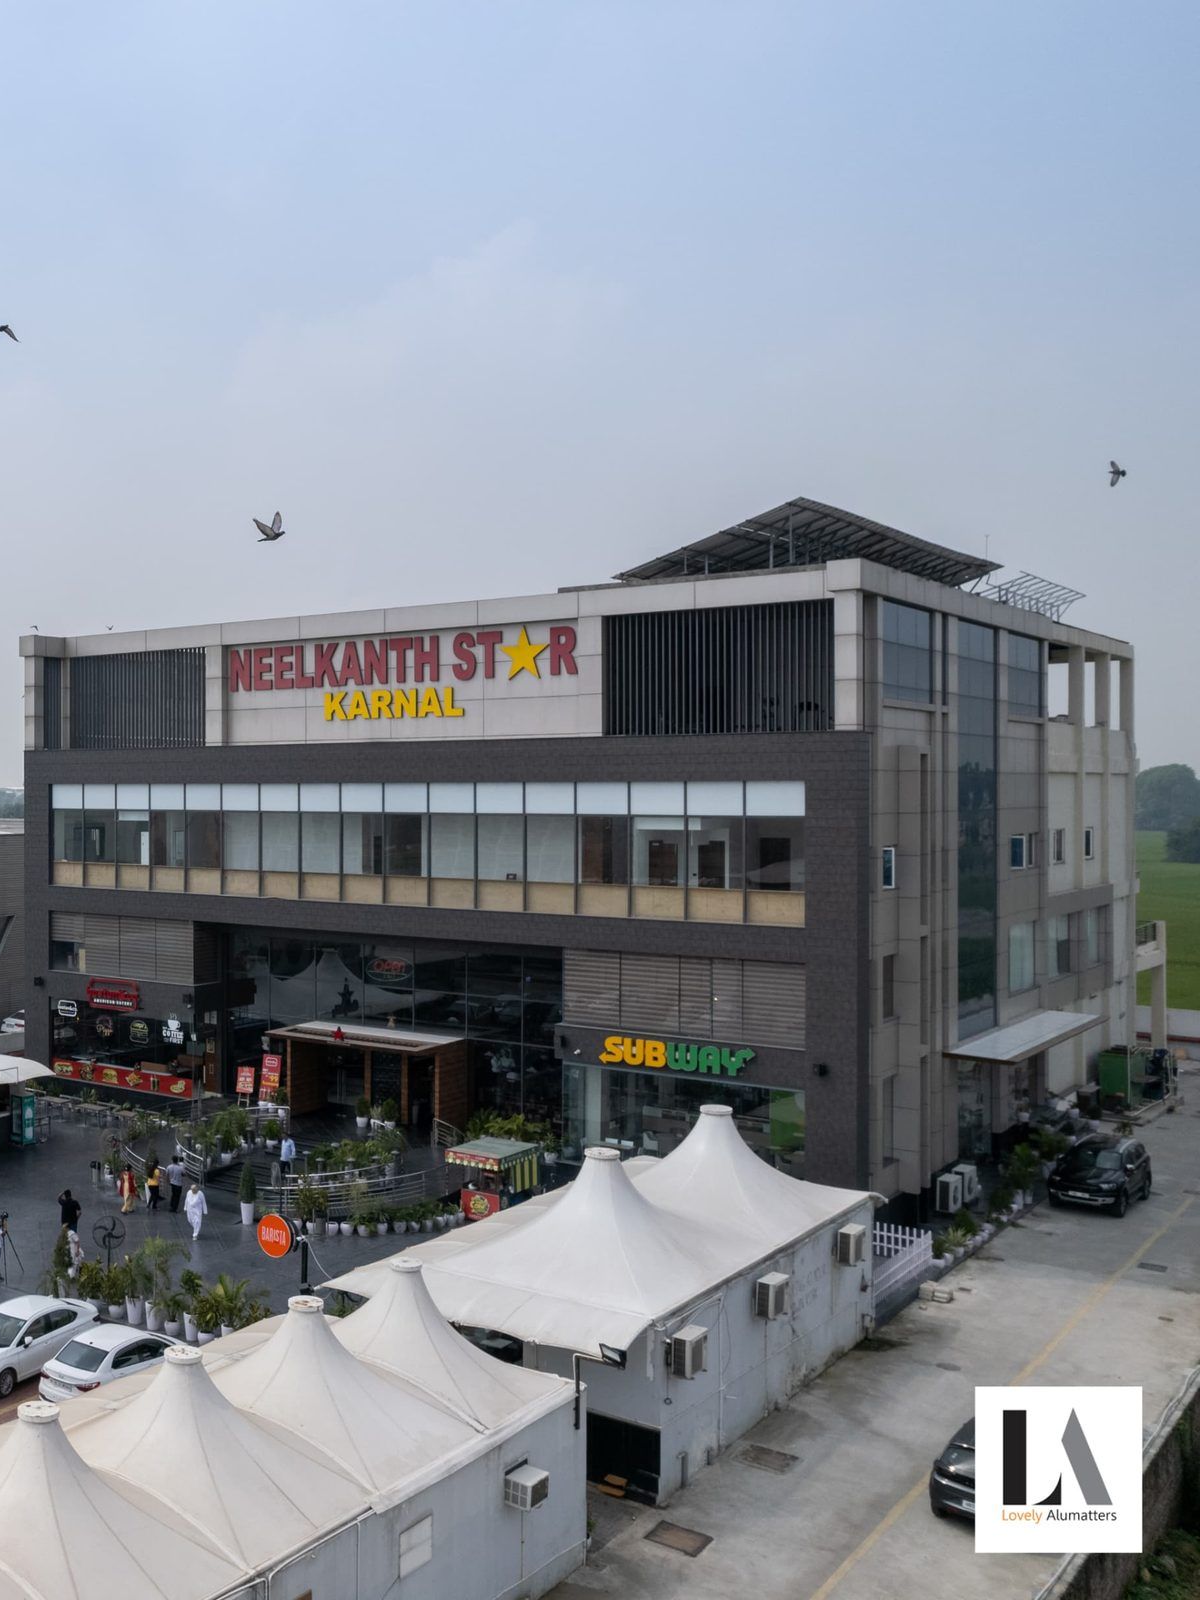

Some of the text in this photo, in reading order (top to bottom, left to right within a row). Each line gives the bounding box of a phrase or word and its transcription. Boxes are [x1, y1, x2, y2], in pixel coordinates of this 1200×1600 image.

[229, 635, 440, 692] NEELKANTH
[324, 687, 465, 721] KARNAL
[599, 1035, 756, 1076] SUBWAY
[261, 1226, 286, 1246] BARISTA
